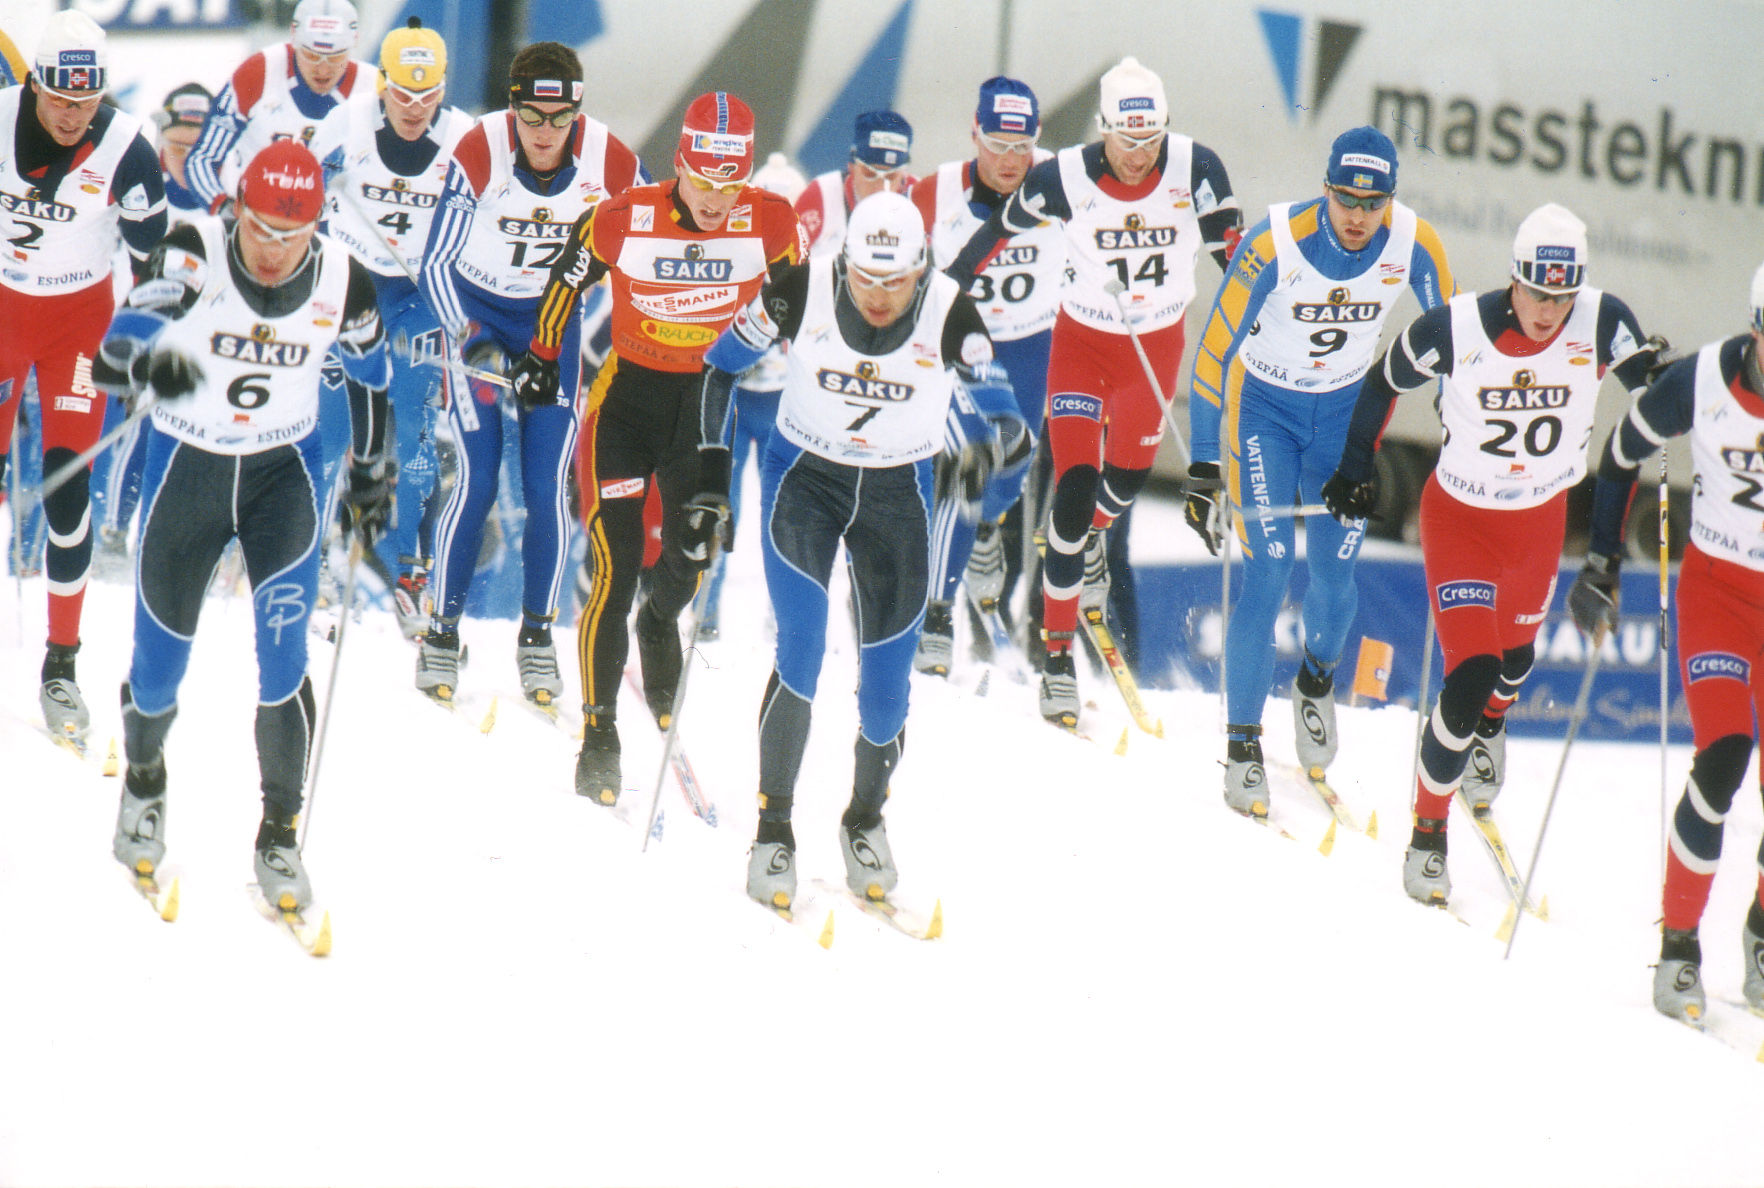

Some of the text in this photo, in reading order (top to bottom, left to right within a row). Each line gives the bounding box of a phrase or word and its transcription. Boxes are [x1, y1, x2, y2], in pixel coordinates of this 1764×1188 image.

[61, 53, 91, 62] Cresco
[1121, 100, 1149, 108] Cresco
[1, 195, 71, 222] SAKU
[366, 187, 434, 208] SAKU
[7, 219, 44, 250] 2
[378, 212, 412, 235] 4
[1101, 229, 1172, 248] SAKU
[505, 241, 565, 269] 12
[989, 248, 1034, 266] KU
[1538, 247, 1570, 257] Cresco
[38, 269, 93, 286] ESTONIA
[660, 261, 726, 280] SAKU
[1106, 254, 1168, 292] 14
[1299, 305, 1375, 321] SAKU
[659, 326, 714, 341] RAUCH
[1308, 328, 1348, 358] 9
[219, 335, 304, 367] SAKU
[227, 373, 272, 410] 6
[824, 372, 910, 400] SAKU
[1053, 398, 1095, 413] Cresco
[1485, 388, 1565, 410] SAKU
[844, 400, 882, 431] 7
[257, 414, 313, 443] ESTONIA
[1479, 415, 1563, 458] 20
[1246, 434, 1277, 538] VATTENFALL
[1441, 586, 1490, 602] Cresco
[1534, 619, 1657, 666] AKU
[1690, 657, 1745, 675] Cresco
